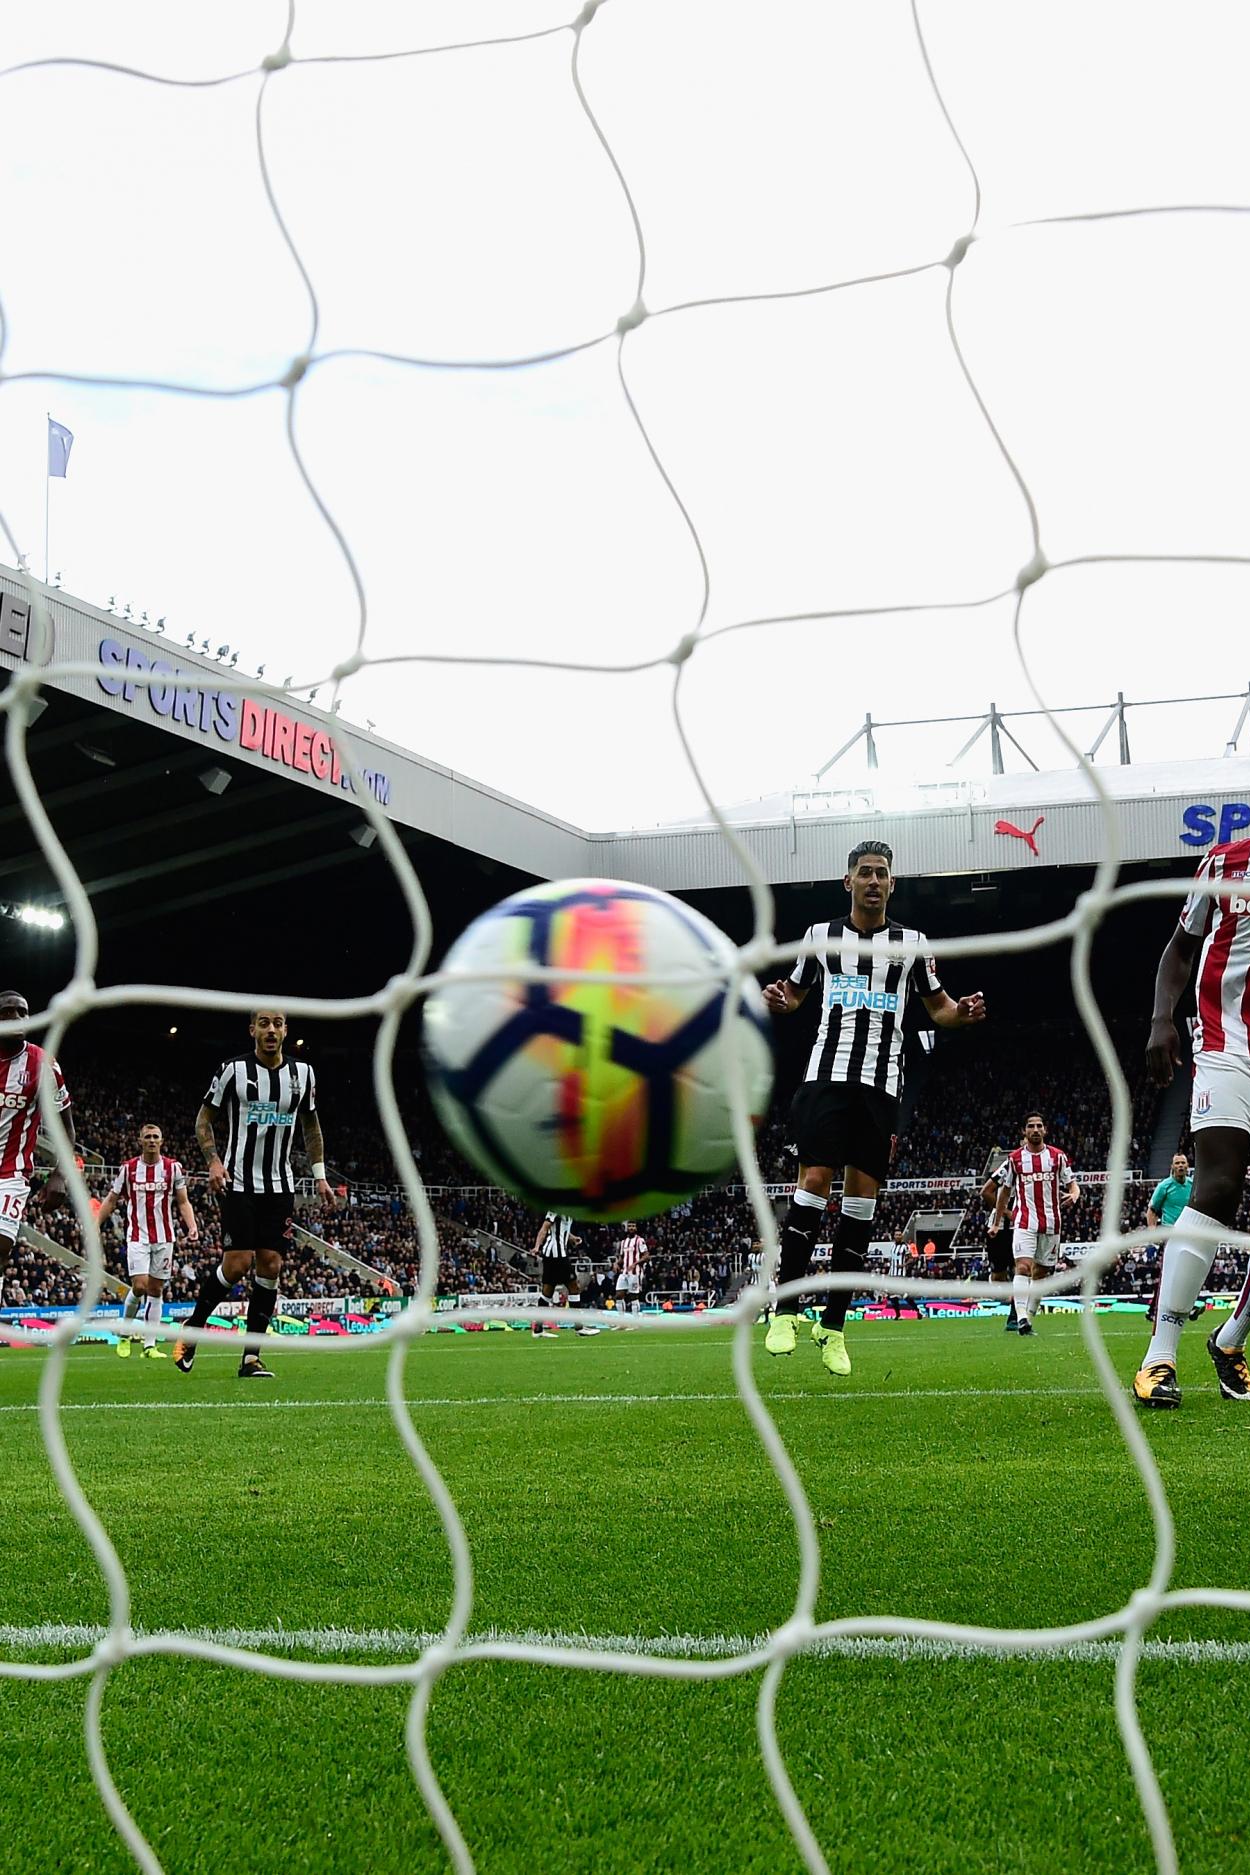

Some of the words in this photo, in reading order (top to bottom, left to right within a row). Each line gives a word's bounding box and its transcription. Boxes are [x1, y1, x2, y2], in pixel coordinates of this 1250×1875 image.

[828, 990, 898, 1012] FUN88
[1020, 1172, 1055, 1182] bet365
[132, 1181, 168, 1191] bet365
[2, 1194, 22, 1219] 15
[1160, 1313, 1185, 1328] scfc
